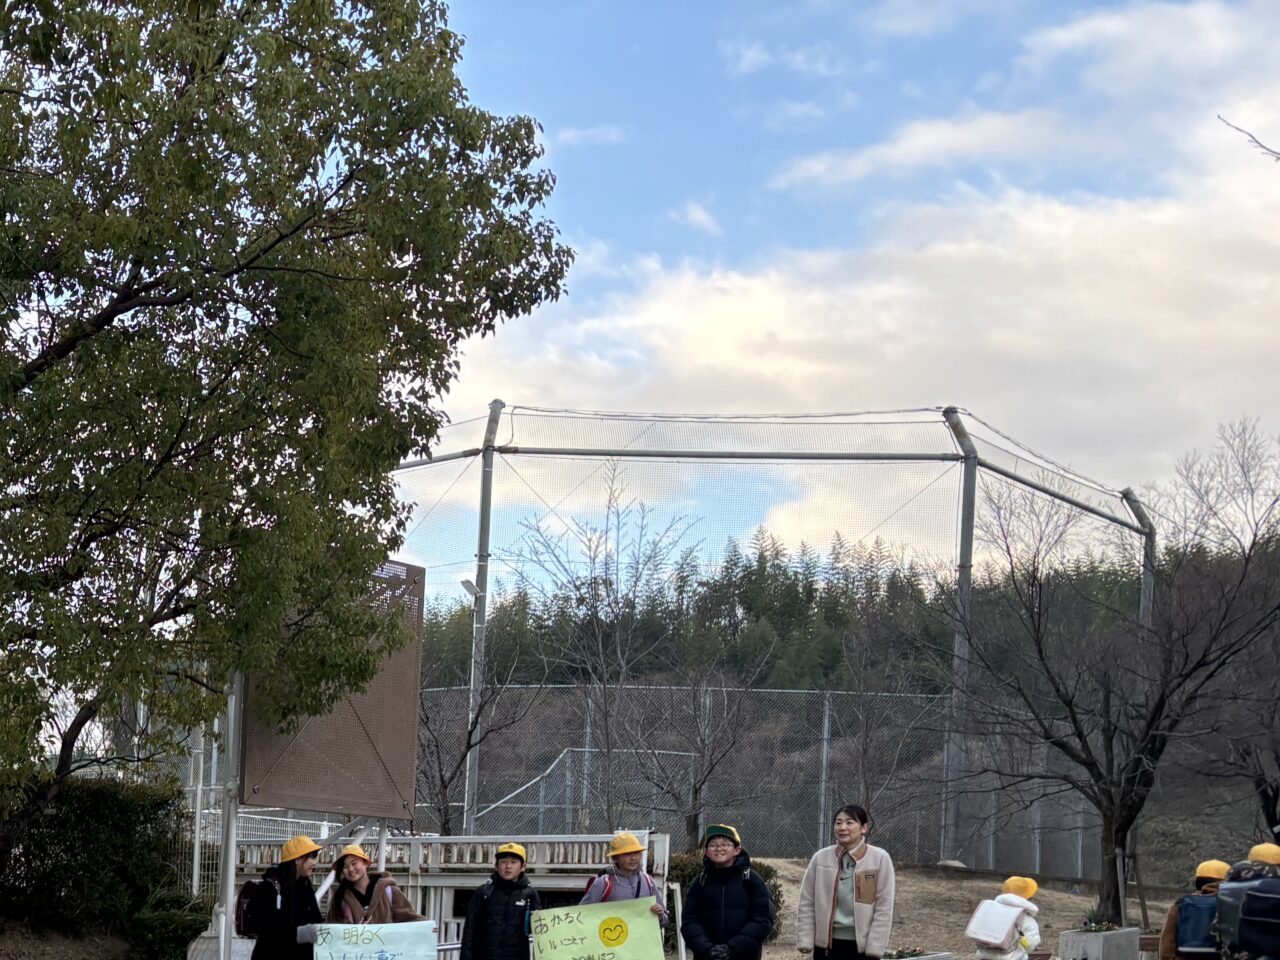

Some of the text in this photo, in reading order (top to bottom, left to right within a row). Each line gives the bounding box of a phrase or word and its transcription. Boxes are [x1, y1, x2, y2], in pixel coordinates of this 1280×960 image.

[316, 926, 385, 946] あ 明るく
